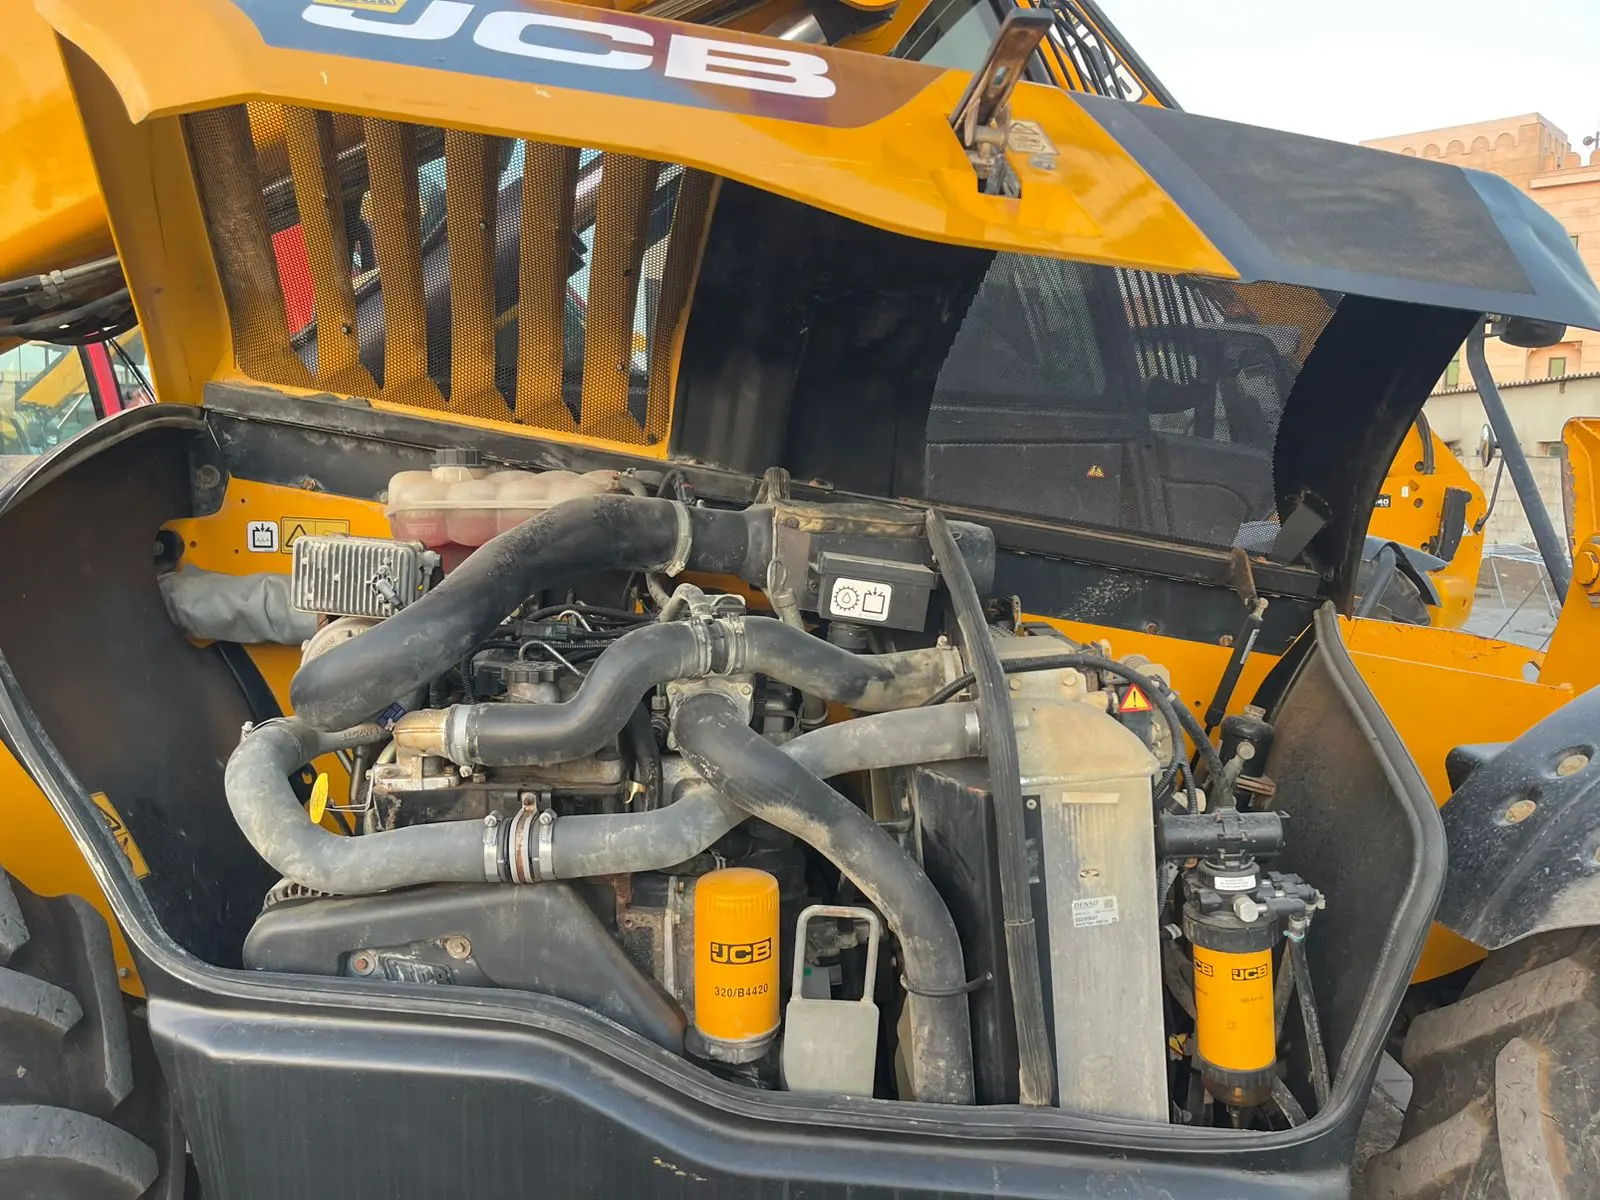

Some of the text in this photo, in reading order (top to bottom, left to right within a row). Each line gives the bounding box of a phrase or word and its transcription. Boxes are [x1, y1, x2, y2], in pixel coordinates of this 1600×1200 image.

[302, 1, 836, 98] JCB
[711, 938, 771, 964] JCB
[1232, 965, 1267, 981] JCB
[714, 983, 769, 998] 320/B4420
